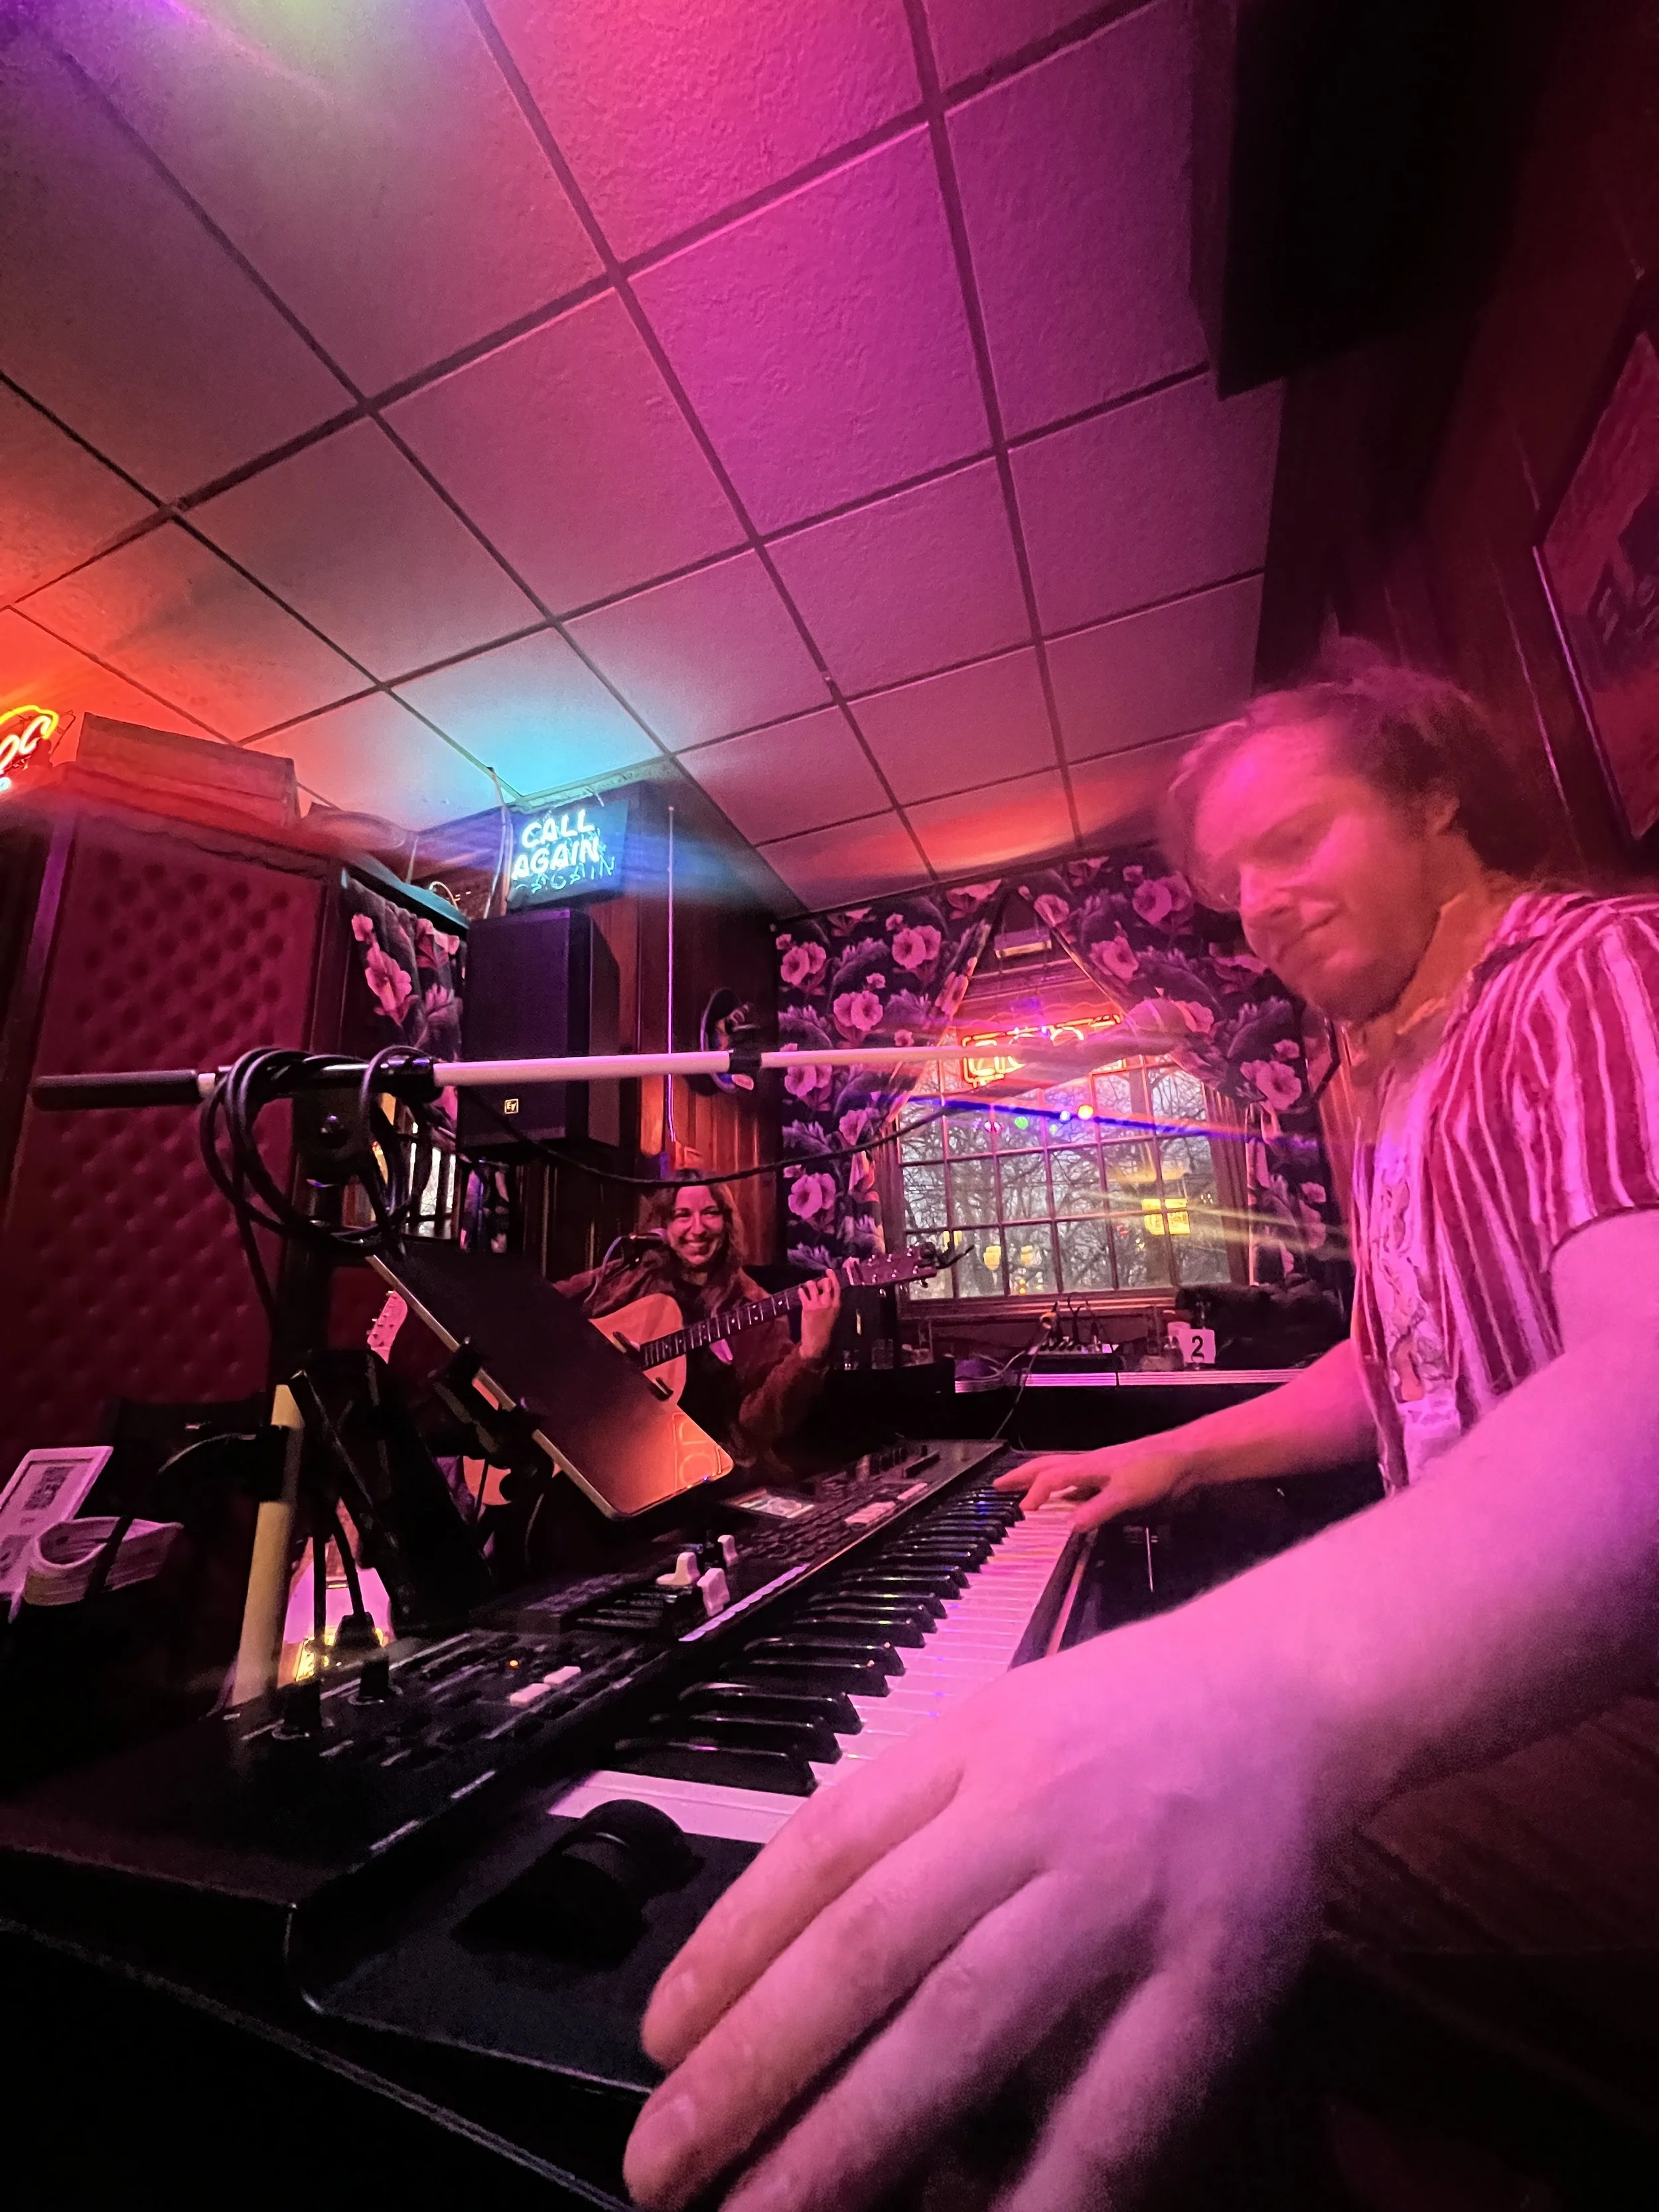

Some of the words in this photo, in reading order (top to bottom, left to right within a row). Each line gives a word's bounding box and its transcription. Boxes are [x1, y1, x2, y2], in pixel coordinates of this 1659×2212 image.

[522, 808, 595, 849] CALL
[511, 836, 600, 881] AGAIN
[1192, 1335, 1204, 1359] 2
